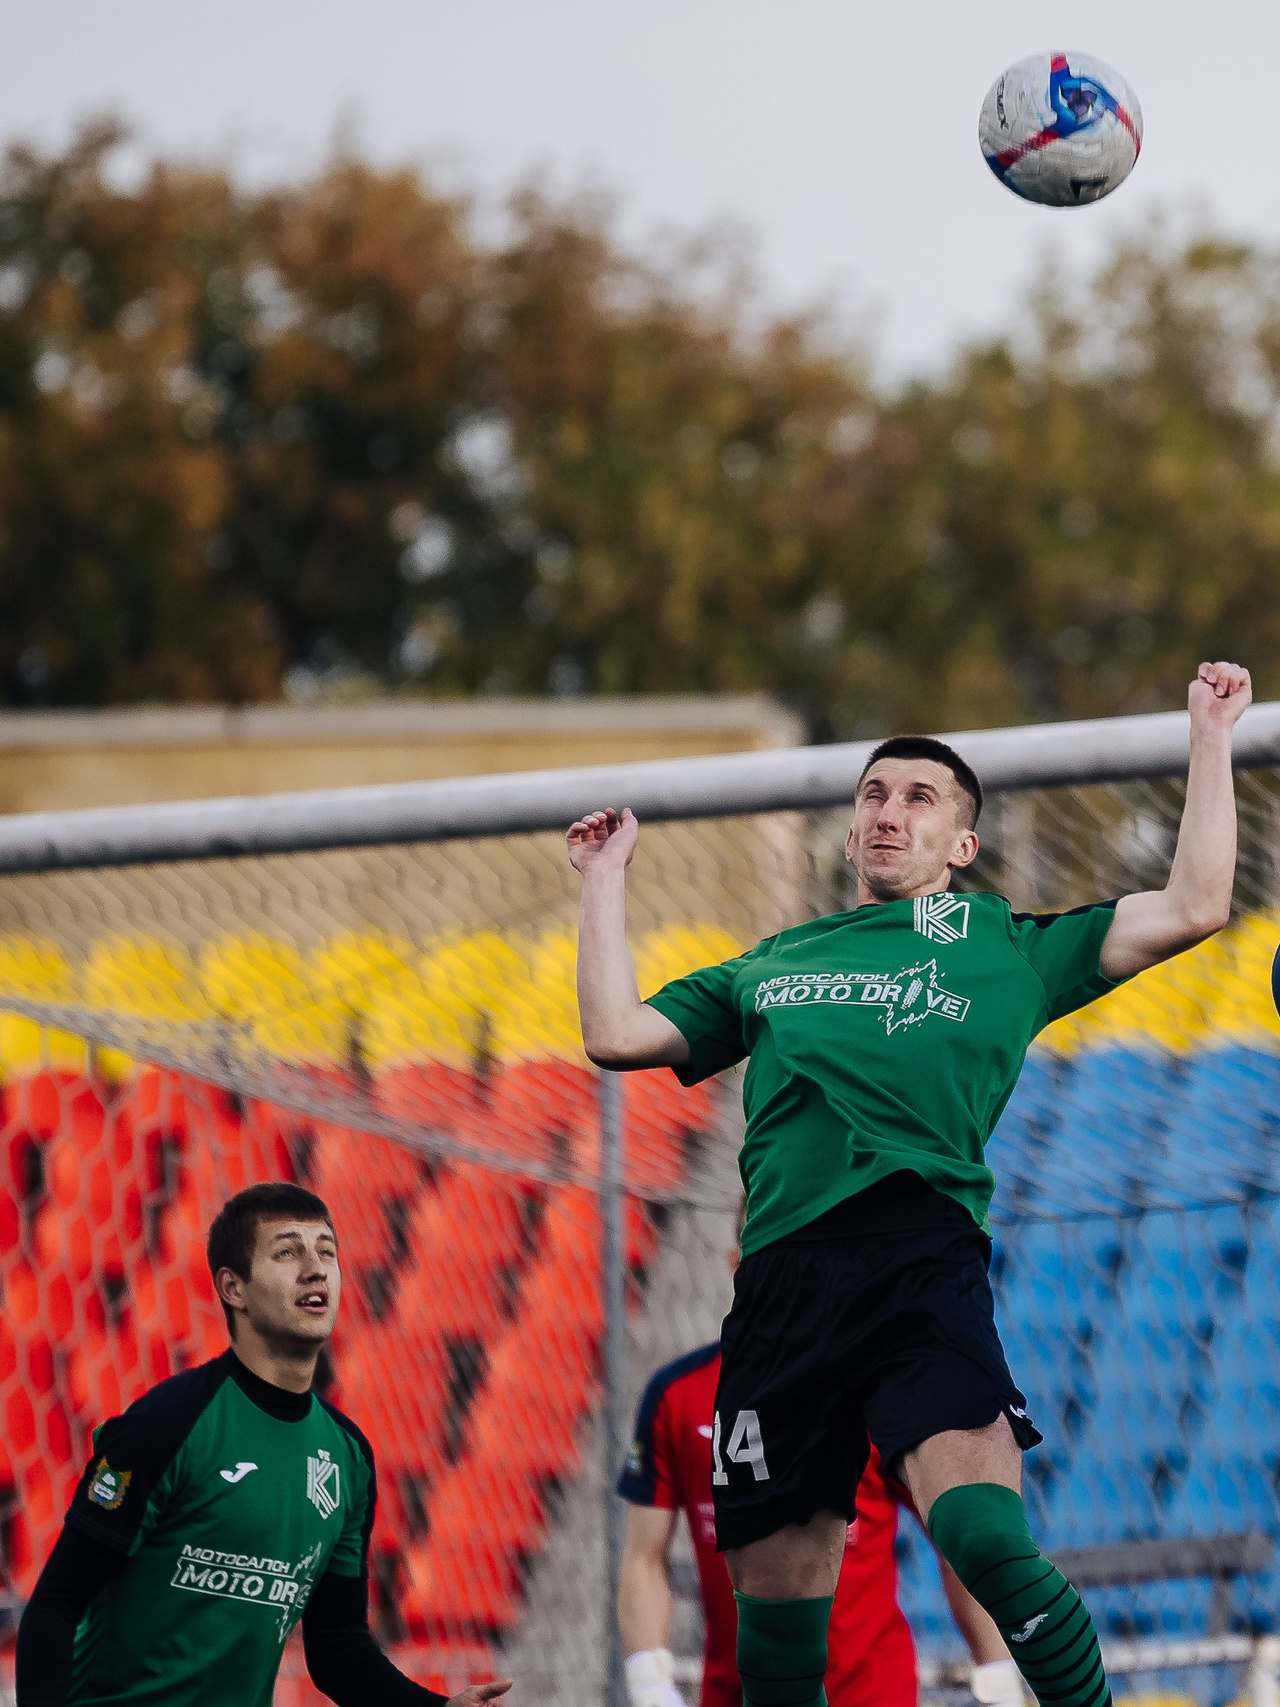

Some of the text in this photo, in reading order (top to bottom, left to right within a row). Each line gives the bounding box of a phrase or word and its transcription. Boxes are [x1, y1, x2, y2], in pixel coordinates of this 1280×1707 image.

[761, 983, 853, 1005] MOTO
[712, 1410, 771, 1486] 14
[179, 1564, 265, 1597] MOTO
